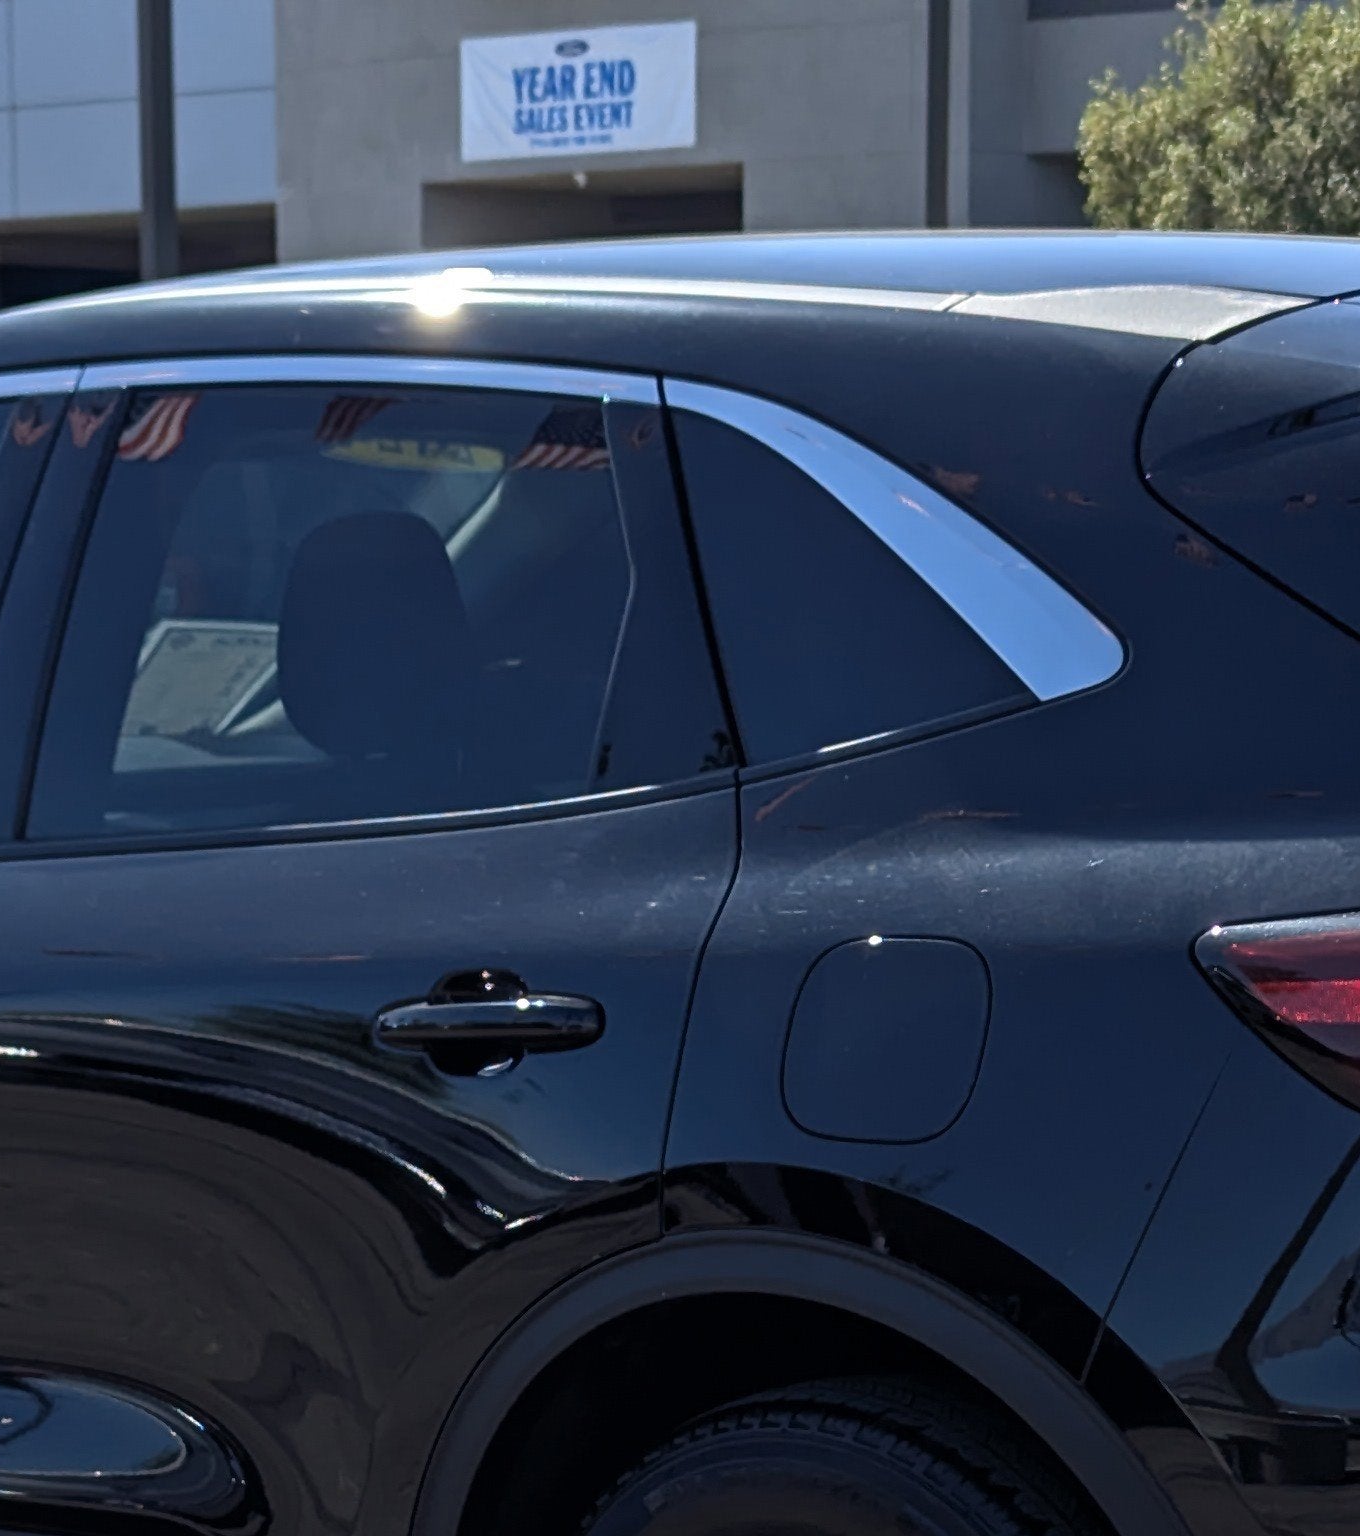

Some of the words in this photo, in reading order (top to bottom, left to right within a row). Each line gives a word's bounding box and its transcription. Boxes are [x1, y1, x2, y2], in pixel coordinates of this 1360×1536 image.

[512, 64, 576, 103] YEAR
[583, 59, 636, 98] END
[513, 104, 568, 134] SALES
[574, 101, 634, 130] EVENT
